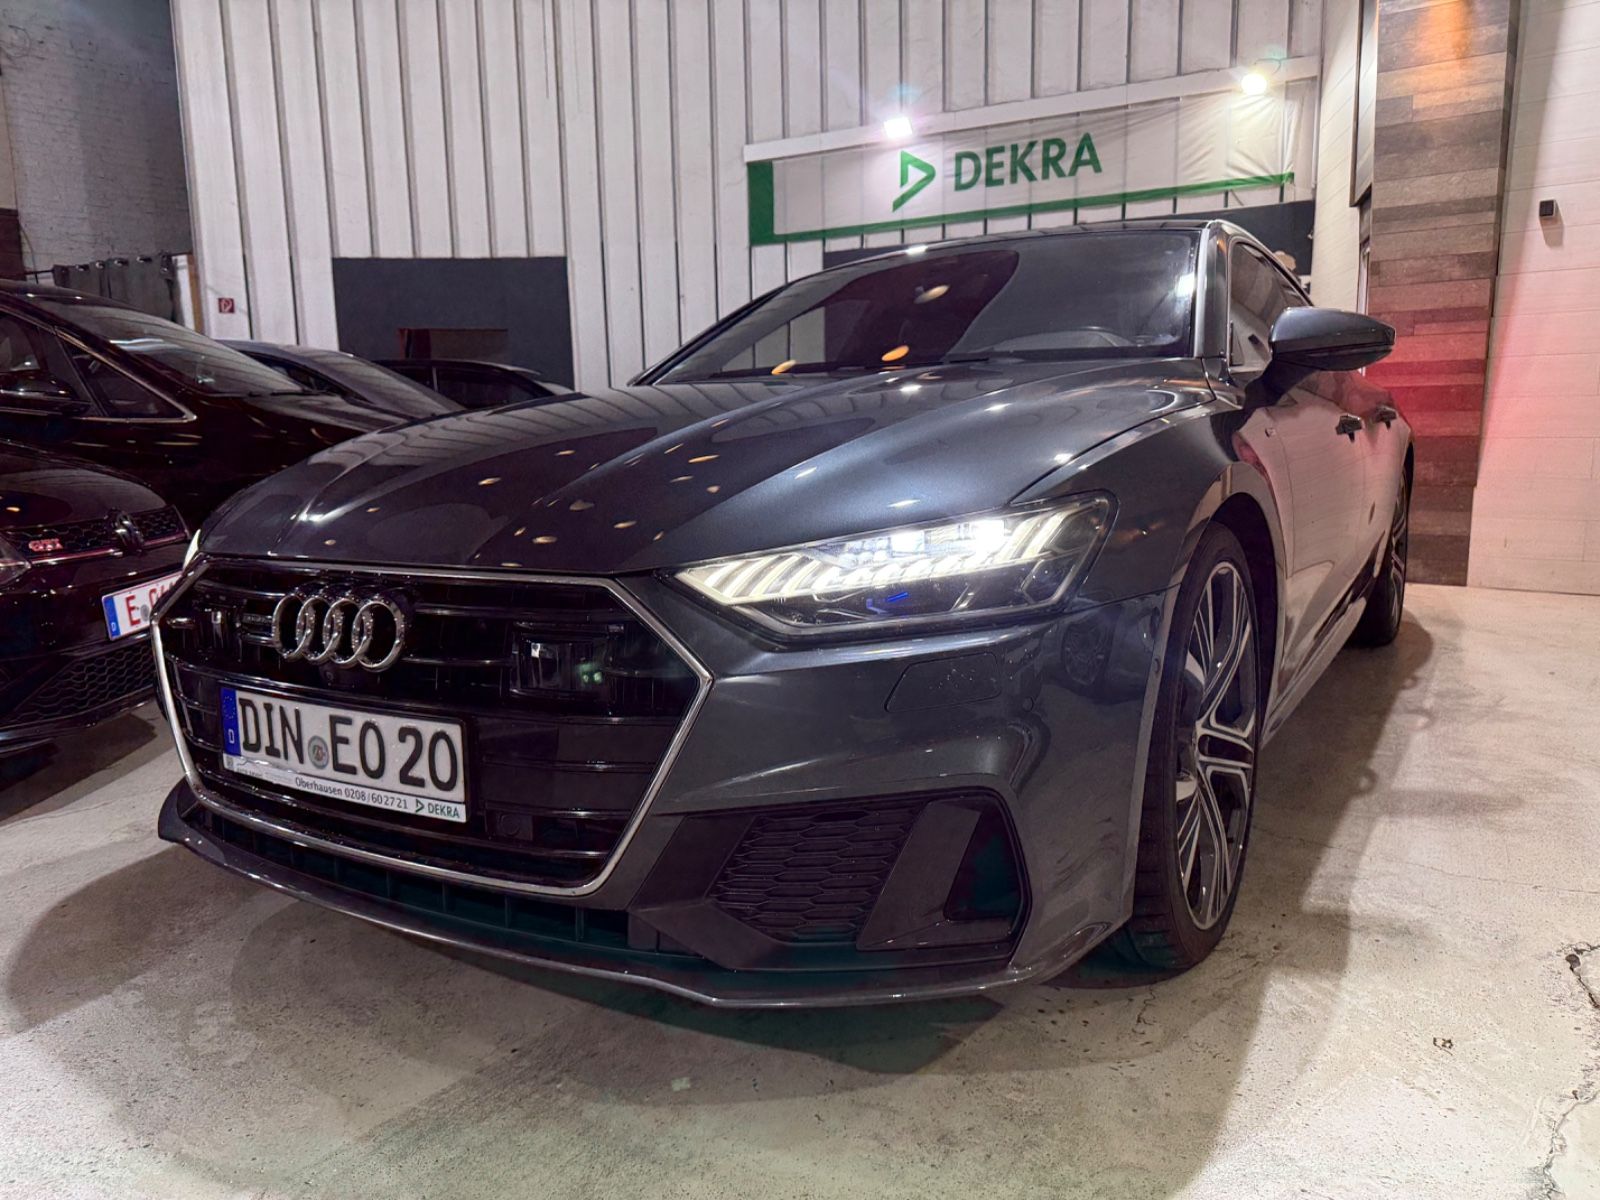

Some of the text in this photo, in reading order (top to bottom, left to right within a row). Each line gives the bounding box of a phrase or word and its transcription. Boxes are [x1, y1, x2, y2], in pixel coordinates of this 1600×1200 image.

[954, 132, 1102, 192] DEKRA
[125, 595, 141, 626] E
[239, 698, 304, 765] DIN
[398, 726, 458, 792] 20
[295, 776, 343, 796] Oberhausen
[427, 802, 460, 818] DEKRA
